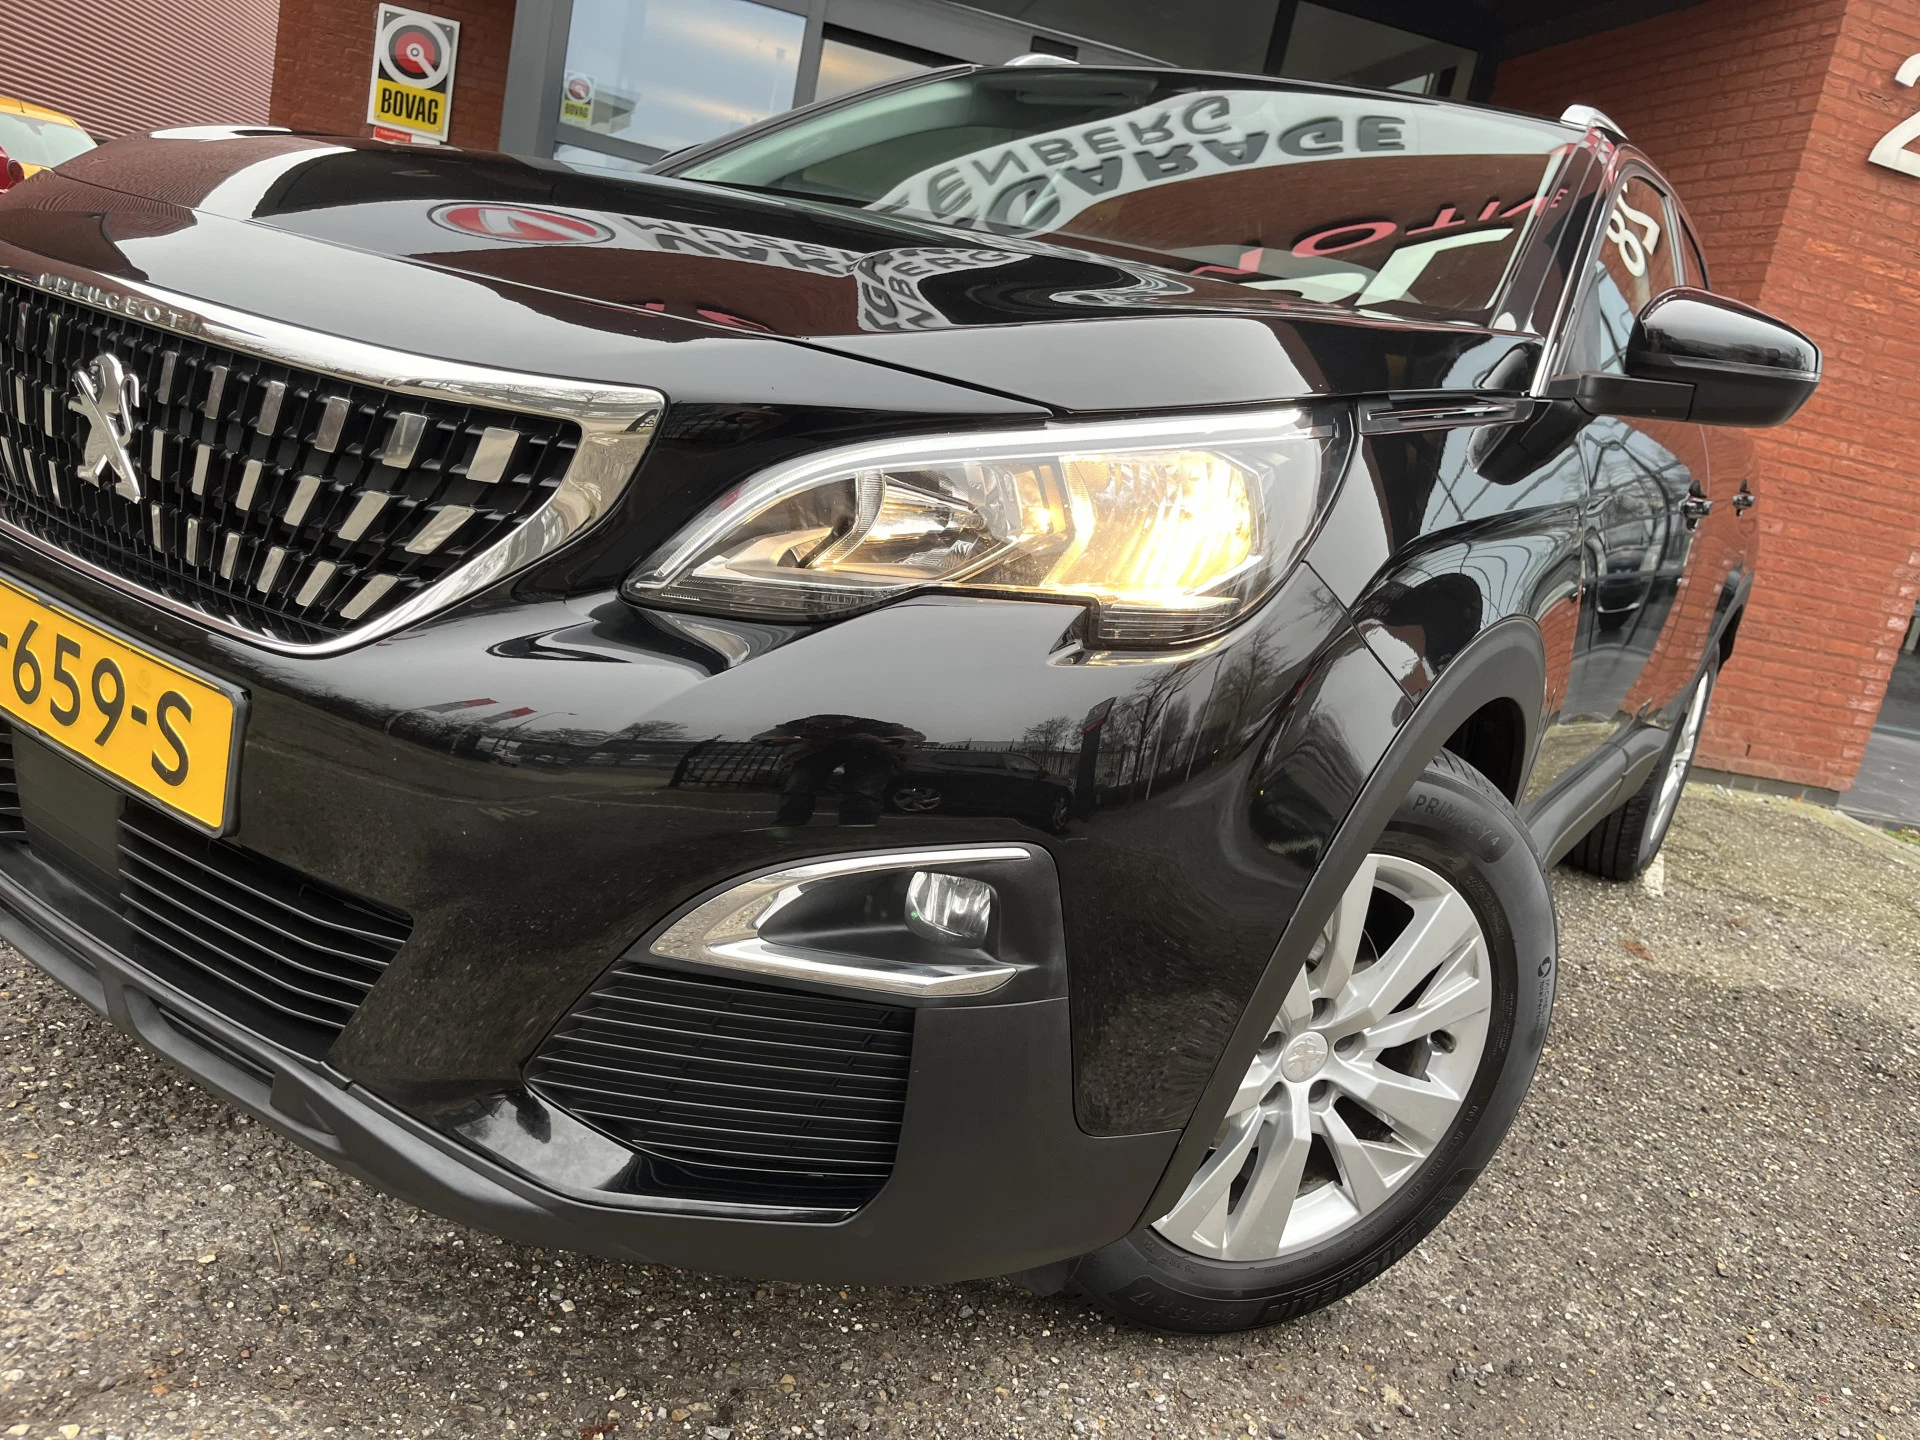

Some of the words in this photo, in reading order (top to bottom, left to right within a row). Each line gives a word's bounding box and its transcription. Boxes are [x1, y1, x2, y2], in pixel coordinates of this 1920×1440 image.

[381, 87, 439, 125] BOVAG
[56, 275, 183, 329] PEUGEOT
[1412, 793, 1492, 841] PRIMACY
[1254, 1226, 1422, 1326] MICHELIN
